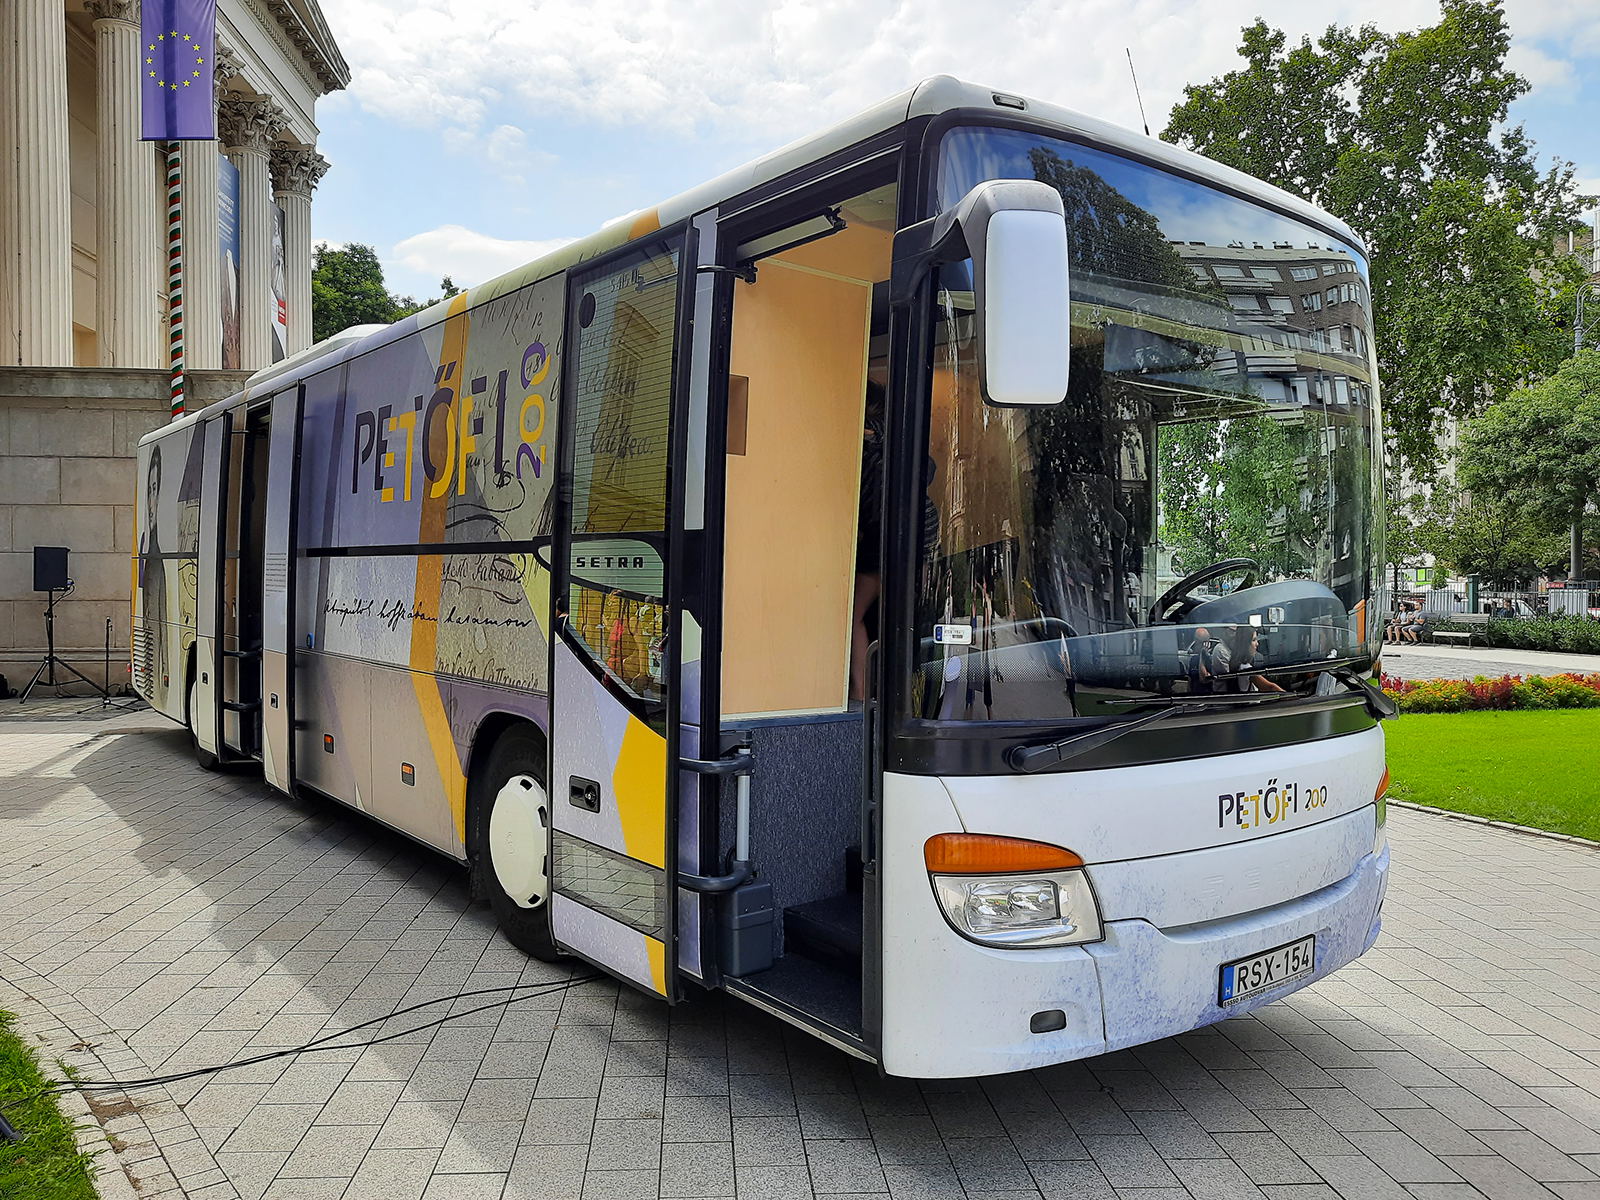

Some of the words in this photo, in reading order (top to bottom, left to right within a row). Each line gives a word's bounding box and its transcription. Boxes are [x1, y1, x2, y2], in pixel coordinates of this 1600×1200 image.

[352, 360, 508, 503] PETŐFI
[516, 342, 551, 480] 200
[576, 556, 645, 569] SETRA
[1218, 778, 1298, 829] PETŐFI
[1304, 785, 1328, 811] 200
[1225, 986, 1231, 996] H
[1237, 942, 1309, 993] RSX-154
